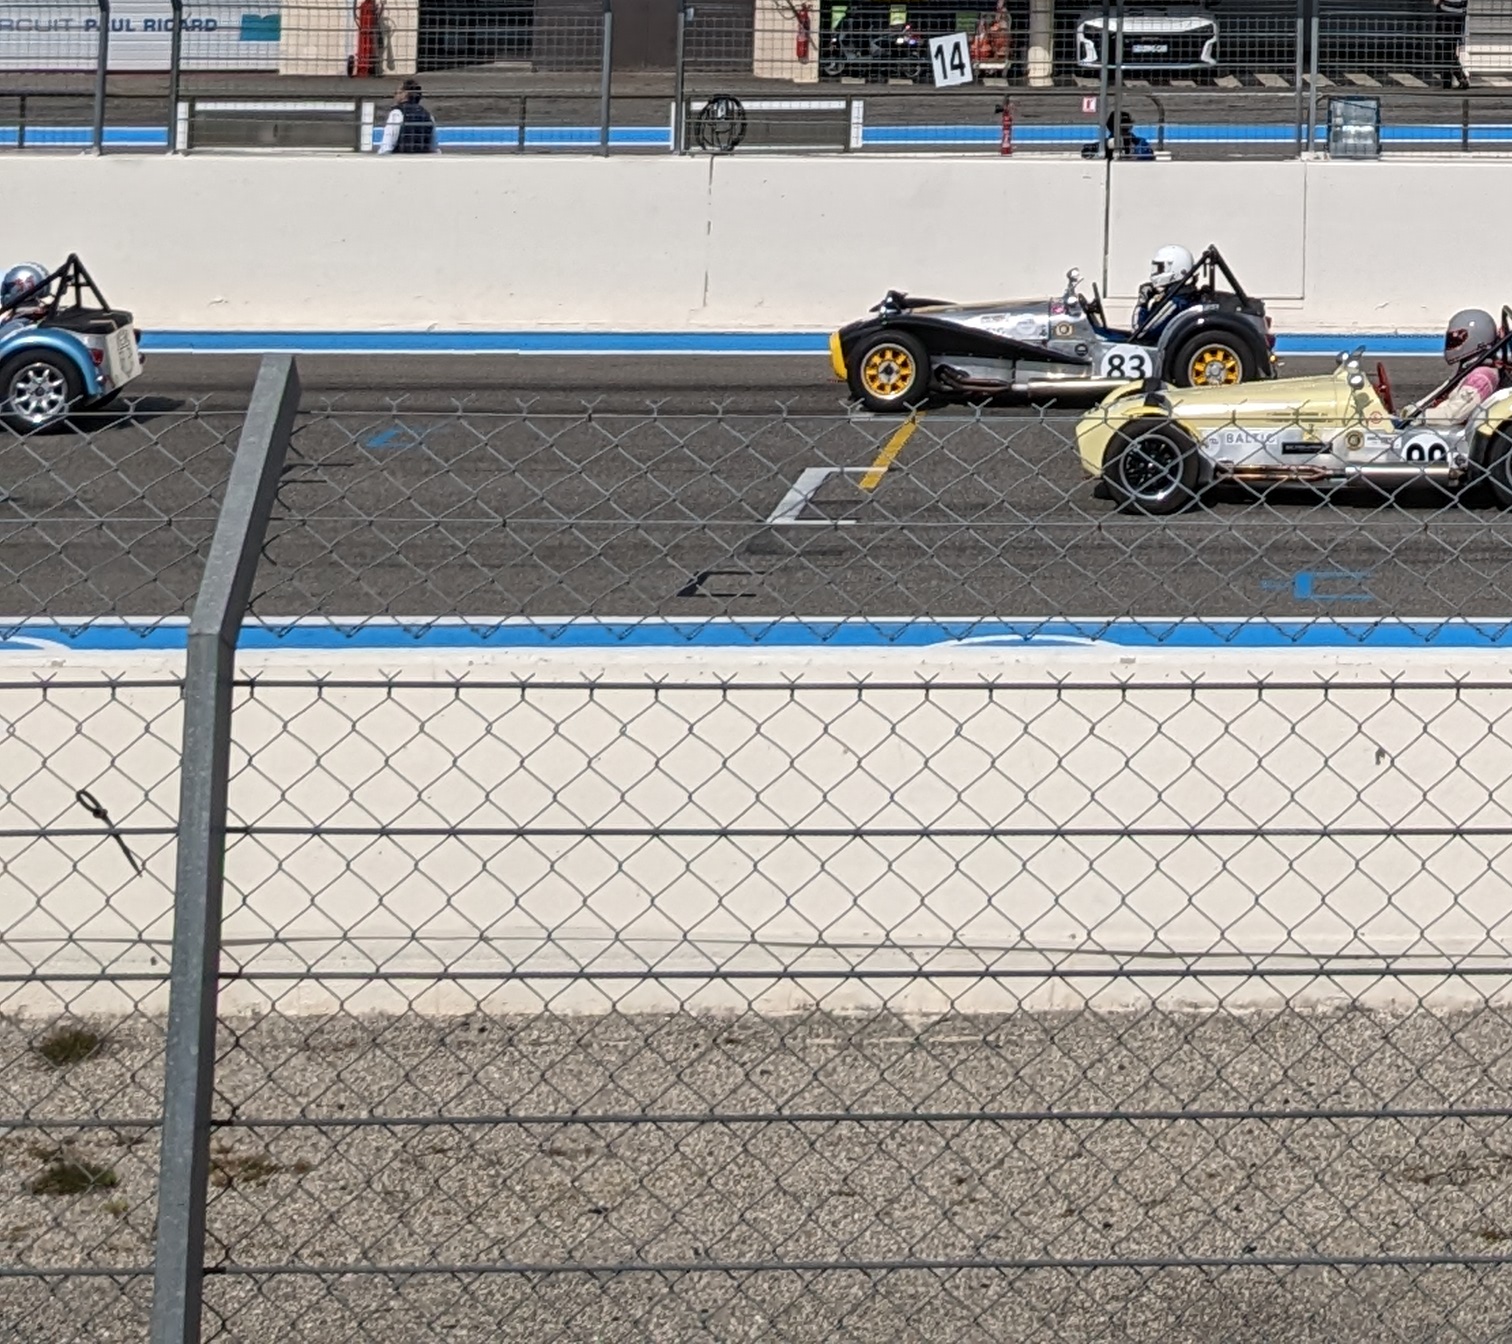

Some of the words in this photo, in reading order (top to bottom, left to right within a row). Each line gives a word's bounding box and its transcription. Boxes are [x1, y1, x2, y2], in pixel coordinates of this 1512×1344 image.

[84, 19, 137, 32] PUL
[933, 40, 966, 81] 14
[1107, 354, 1146, 379] 83
[1226, 432, 1276, 444] BALTIC
